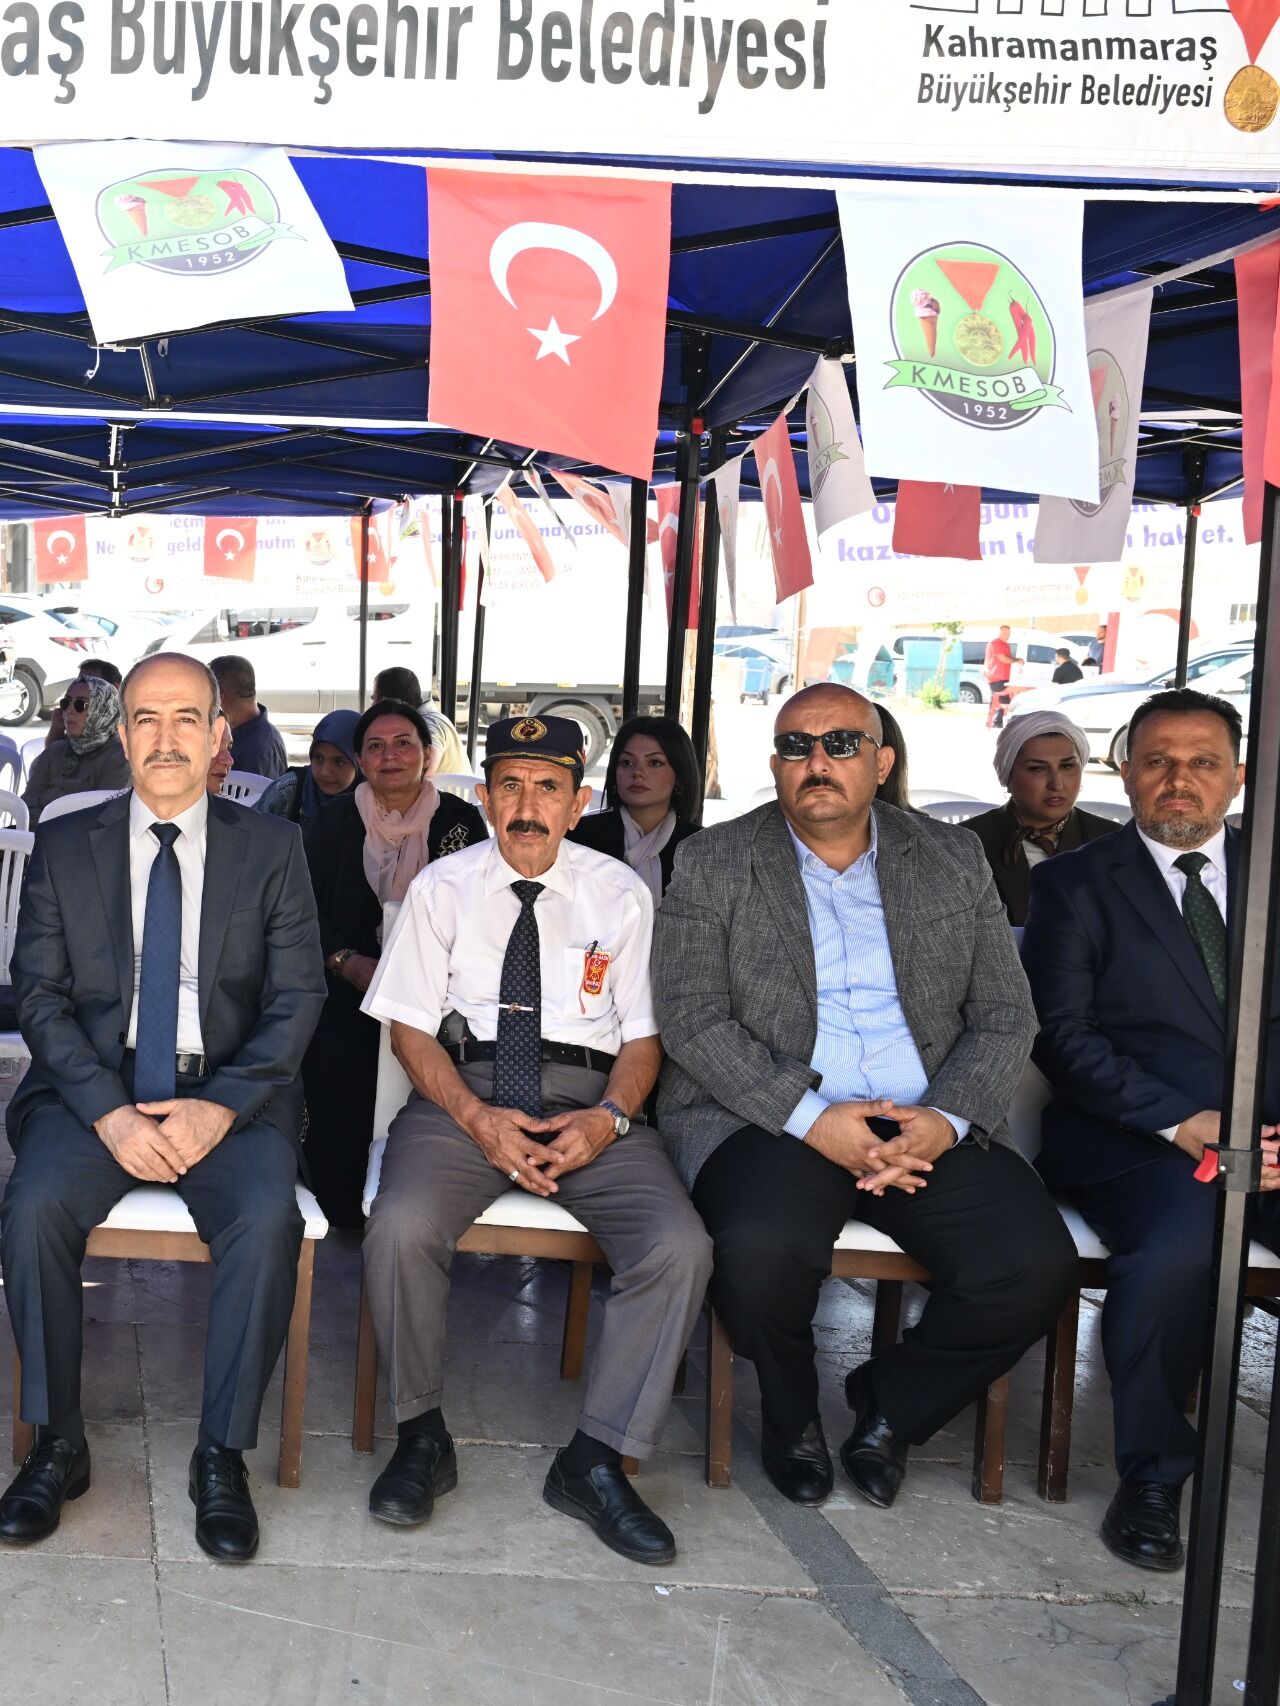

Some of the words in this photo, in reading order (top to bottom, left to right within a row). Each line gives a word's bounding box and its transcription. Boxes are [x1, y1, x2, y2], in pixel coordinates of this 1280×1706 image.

[496, 0, 829, 114] Belediyesi
[922, 23, 1218, 71] Kahramanmaraş
[917, 71, 1072, 113] Büyükşehir
[1080, 73, 1214, 115] Belediyesi
[128, 225, 251, 260] KMESOB
[185, 252, 236, 268] 1952
[911, 364, 1027, 398] KMESOB
[962, 402, 1007, 419] 1952
